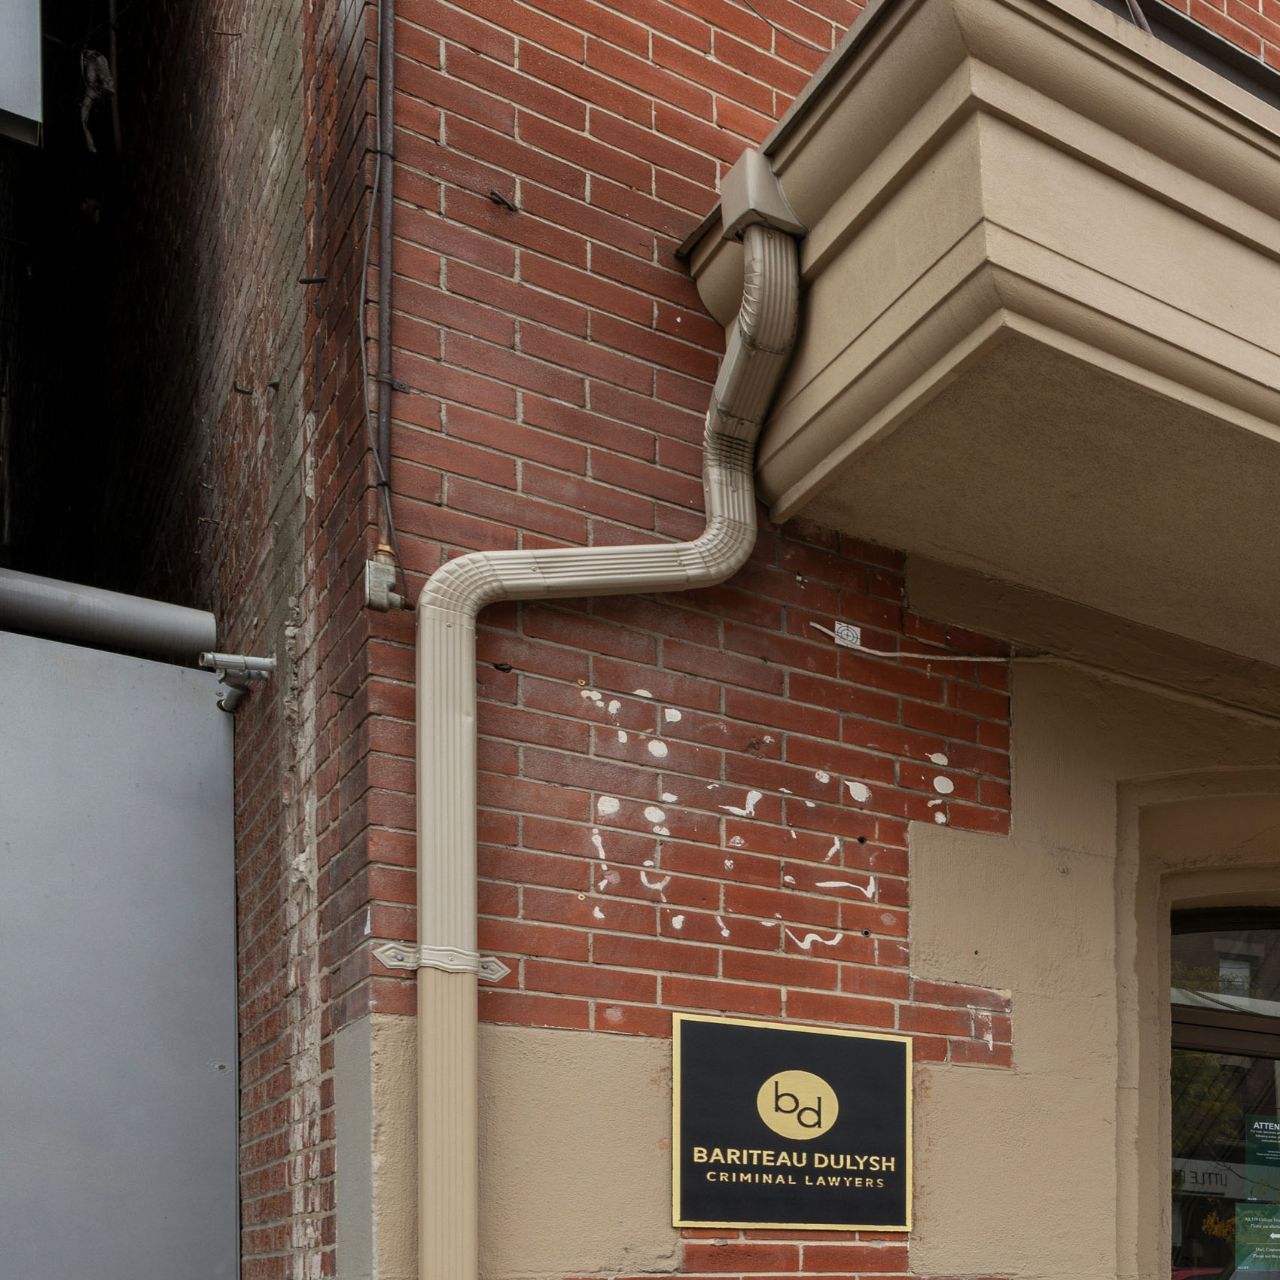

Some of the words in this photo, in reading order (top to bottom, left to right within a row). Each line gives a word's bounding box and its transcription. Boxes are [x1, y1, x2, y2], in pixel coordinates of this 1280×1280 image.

[774, 1080, 822, 1129] bd
[693, 1146, 808, 1168] BARITEAU
[813, 1152, 896, 1172] DULYSH
[706, 1170, 797, 1186] CRIMINAL
[805, 1175, 885, 1188] LAWYERS
